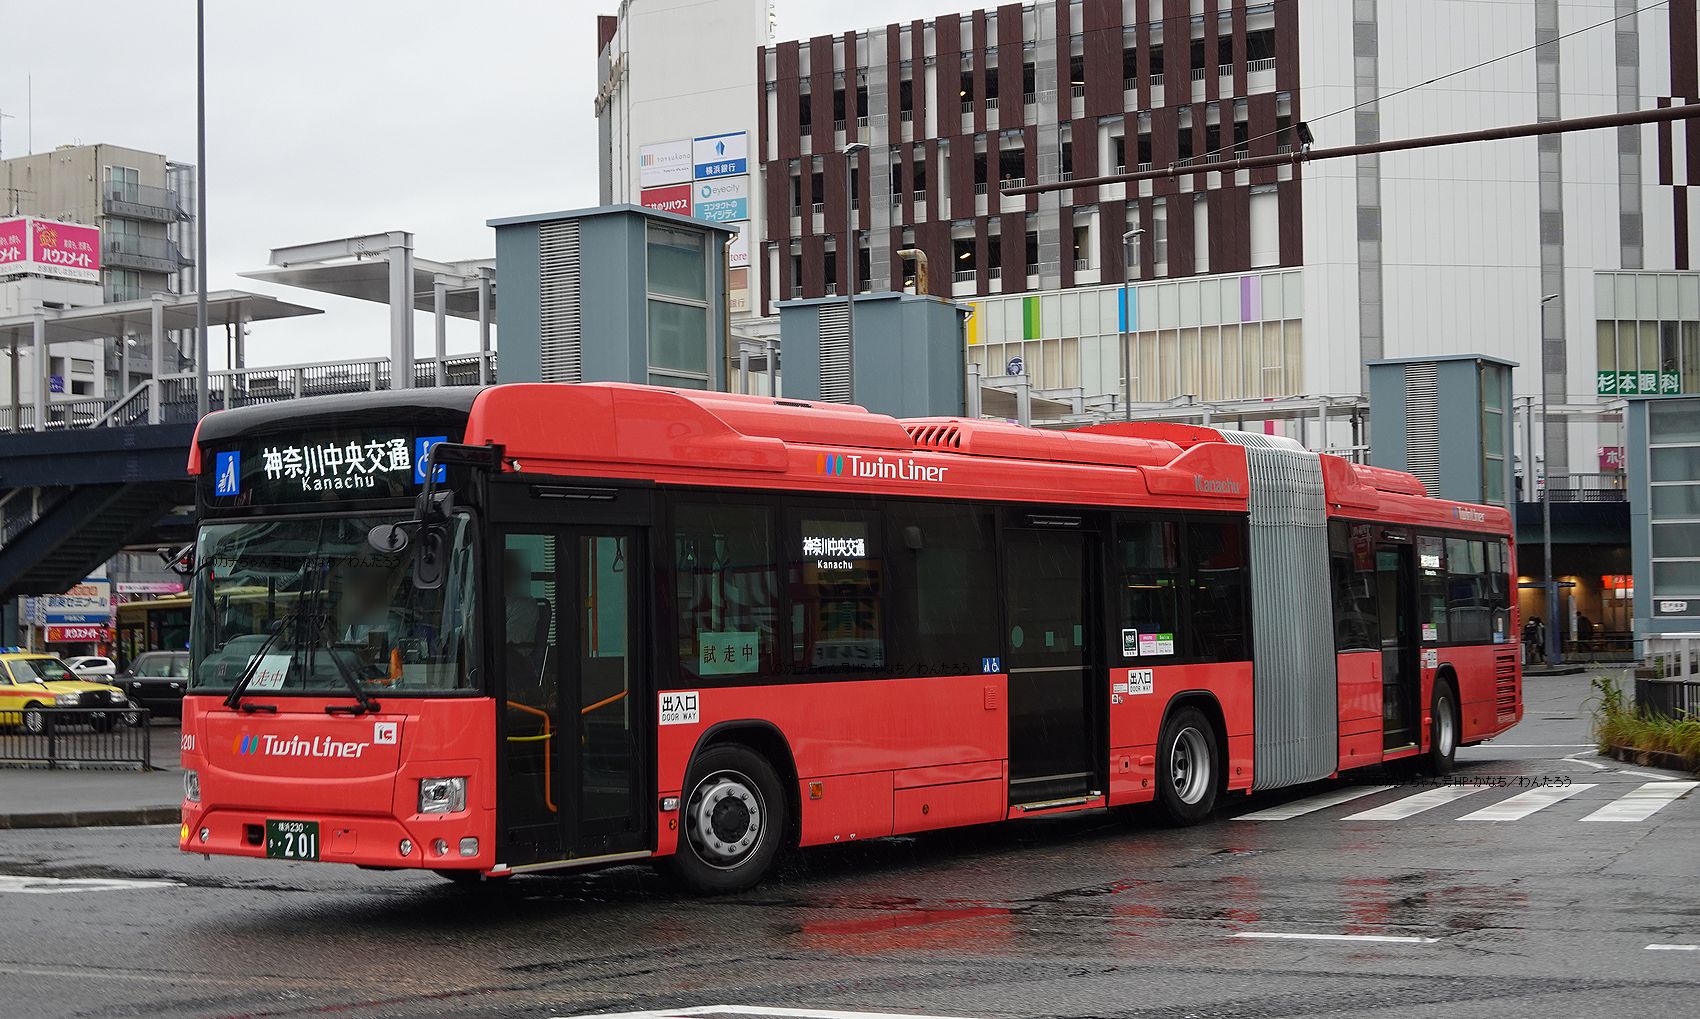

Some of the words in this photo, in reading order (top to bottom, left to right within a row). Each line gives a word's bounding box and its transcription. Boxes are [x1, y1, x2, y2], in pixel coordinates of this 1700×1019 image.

[705, 162, 736, 175] 横浜銀行
[712, 184, 740, 195] eyecity
[42, 248, 93, 267] ハウスメイト
[1598, 374, 1679, 392] 杉本眼科
[262, 438, 412, 480] 神奈川中央交通
[301, 473, 376, 492] Kanachu
[1194, 474, 1240, 494] Kanachu
[803, 536, 866, 557] 神奈川中央交通
[817, 560, 853, 570] Kanachu
[703, 643, 754, 664] 試走中
[252, 669, 283, 688] 走中
[1130, 672, 1152, 685] 出入口
[662, 695, 697, 713] 出入口
[662, 713, 680, 722] DOOR
[683, 712, 697, 720] WAY
